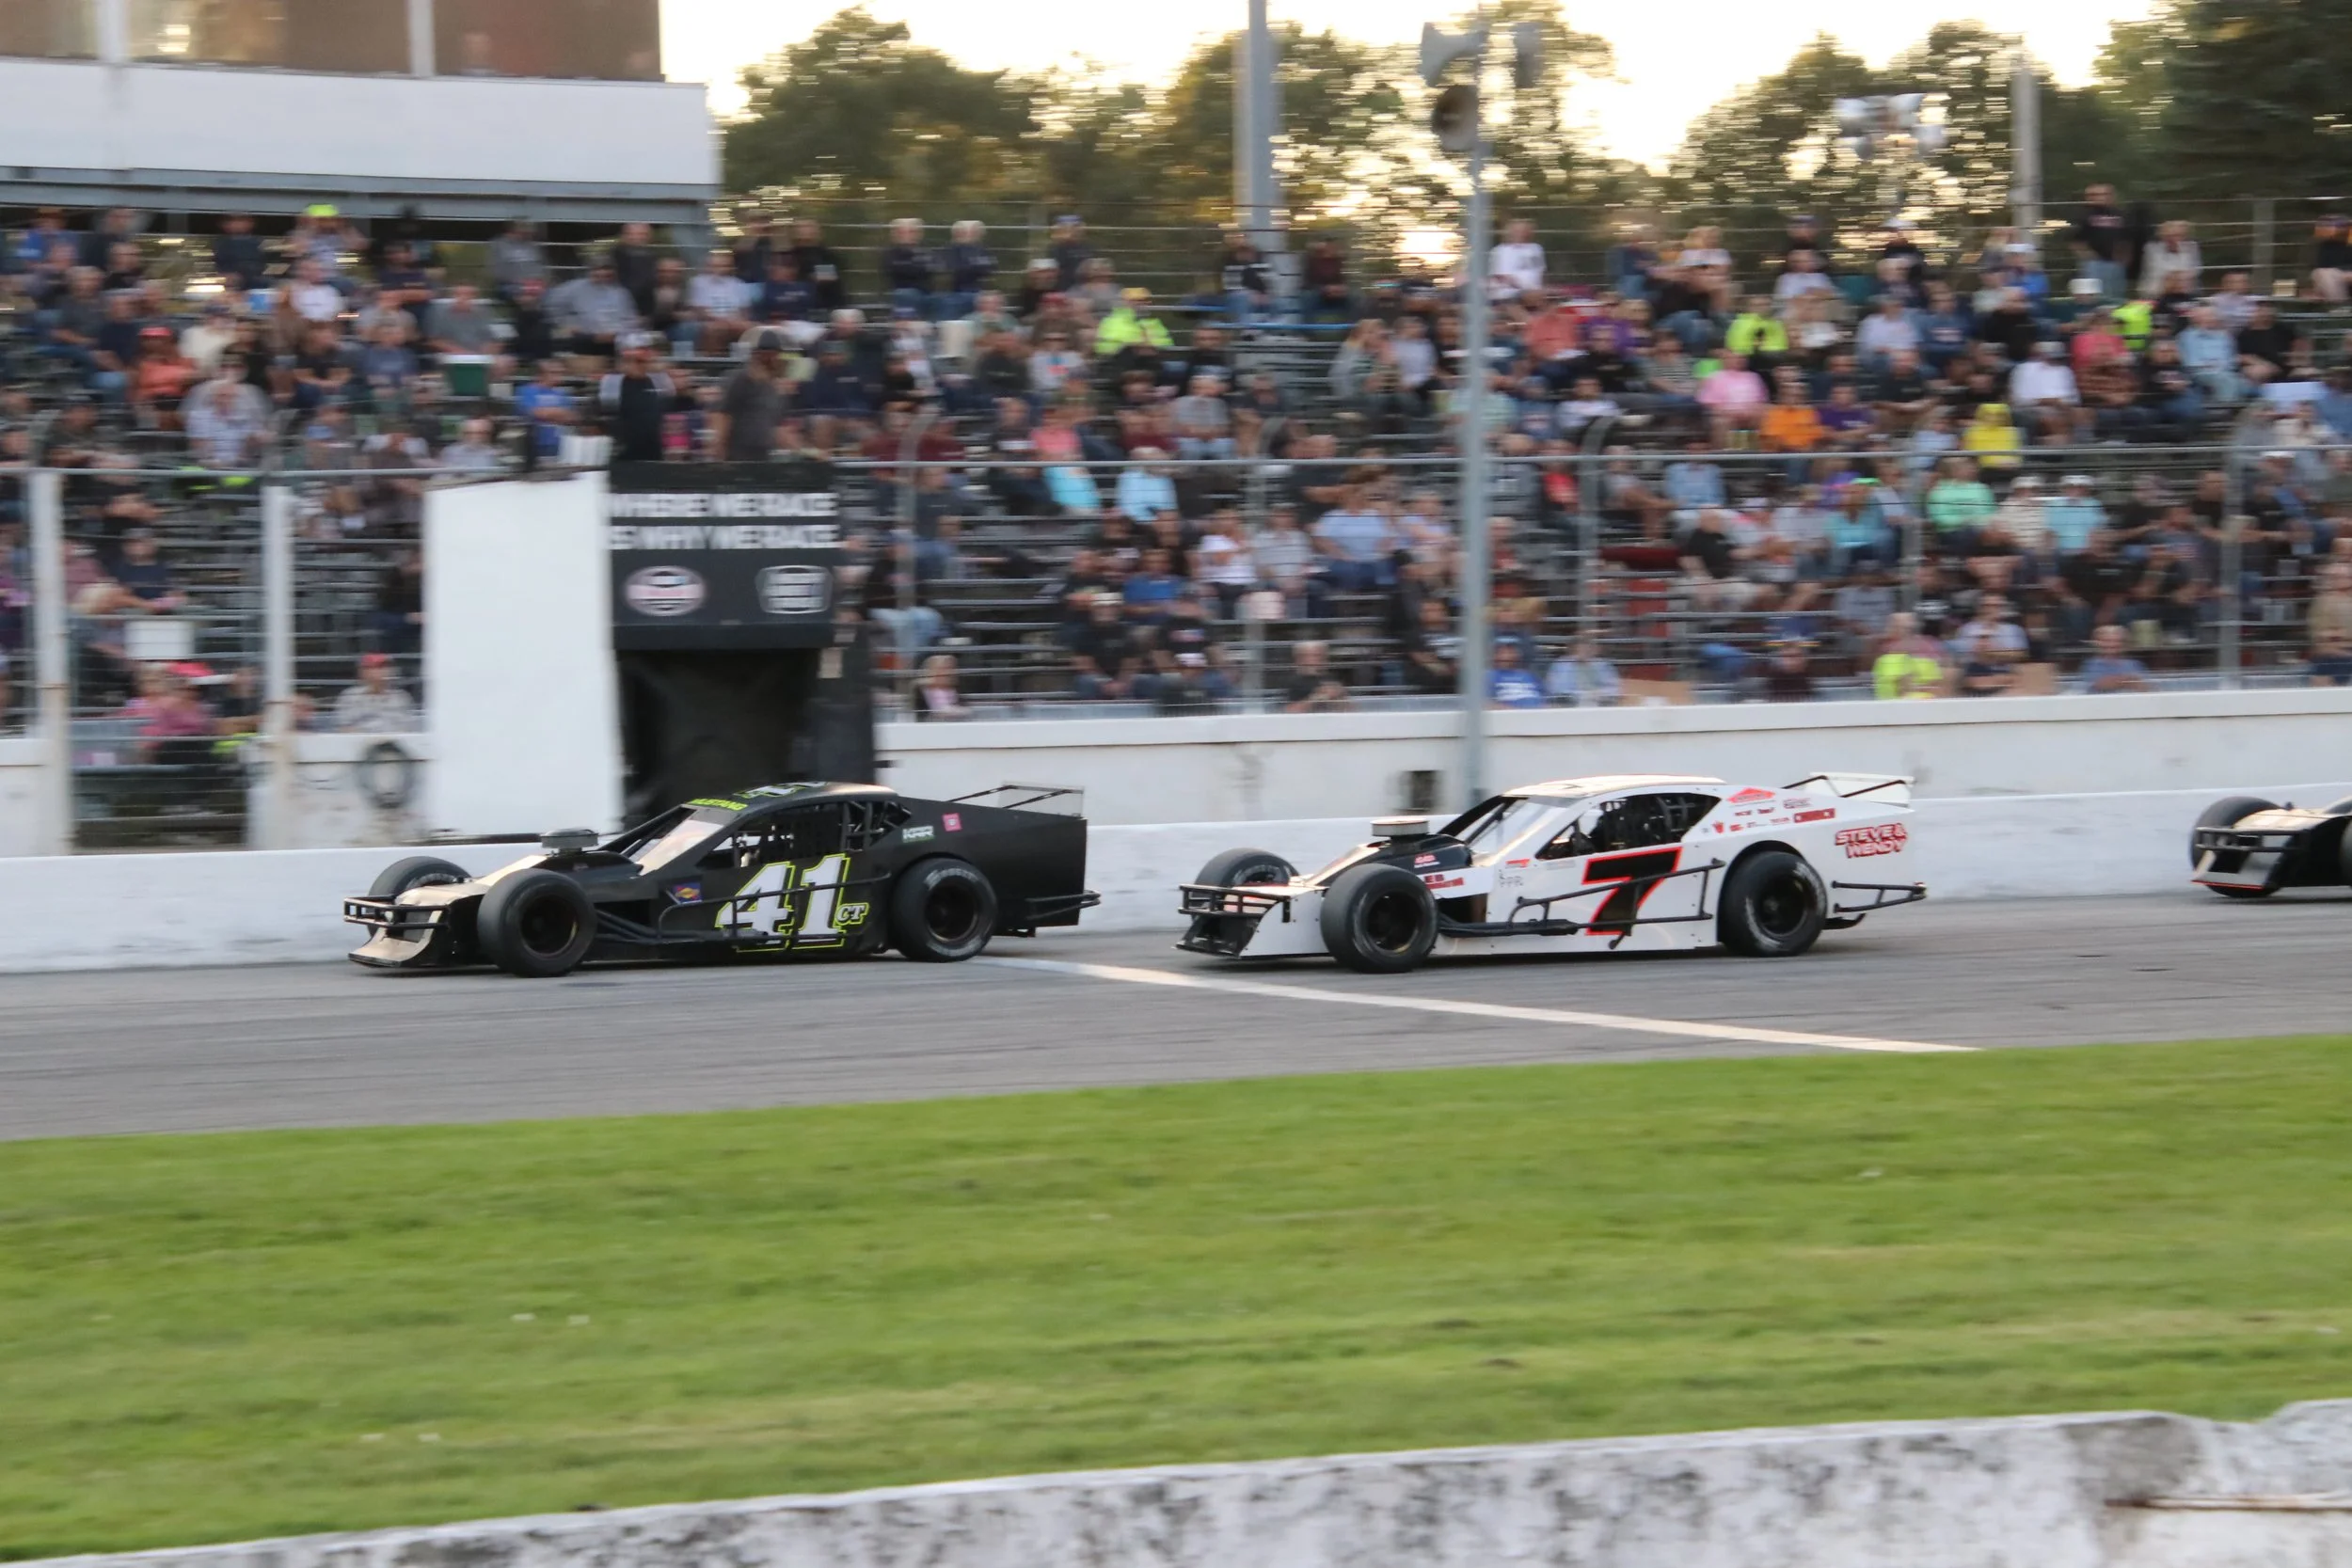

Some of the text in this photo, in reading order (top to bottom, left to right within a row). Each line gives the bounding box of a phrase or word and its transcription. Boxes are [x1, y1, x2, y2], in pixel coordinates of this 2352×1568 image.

[1836, 824, 1894, 846] STEVE
[1846, 839, 1905, 858] WENDY
[715, 853, 868, 952] 41 CT
[1581, 847, 1683, 936] 7
